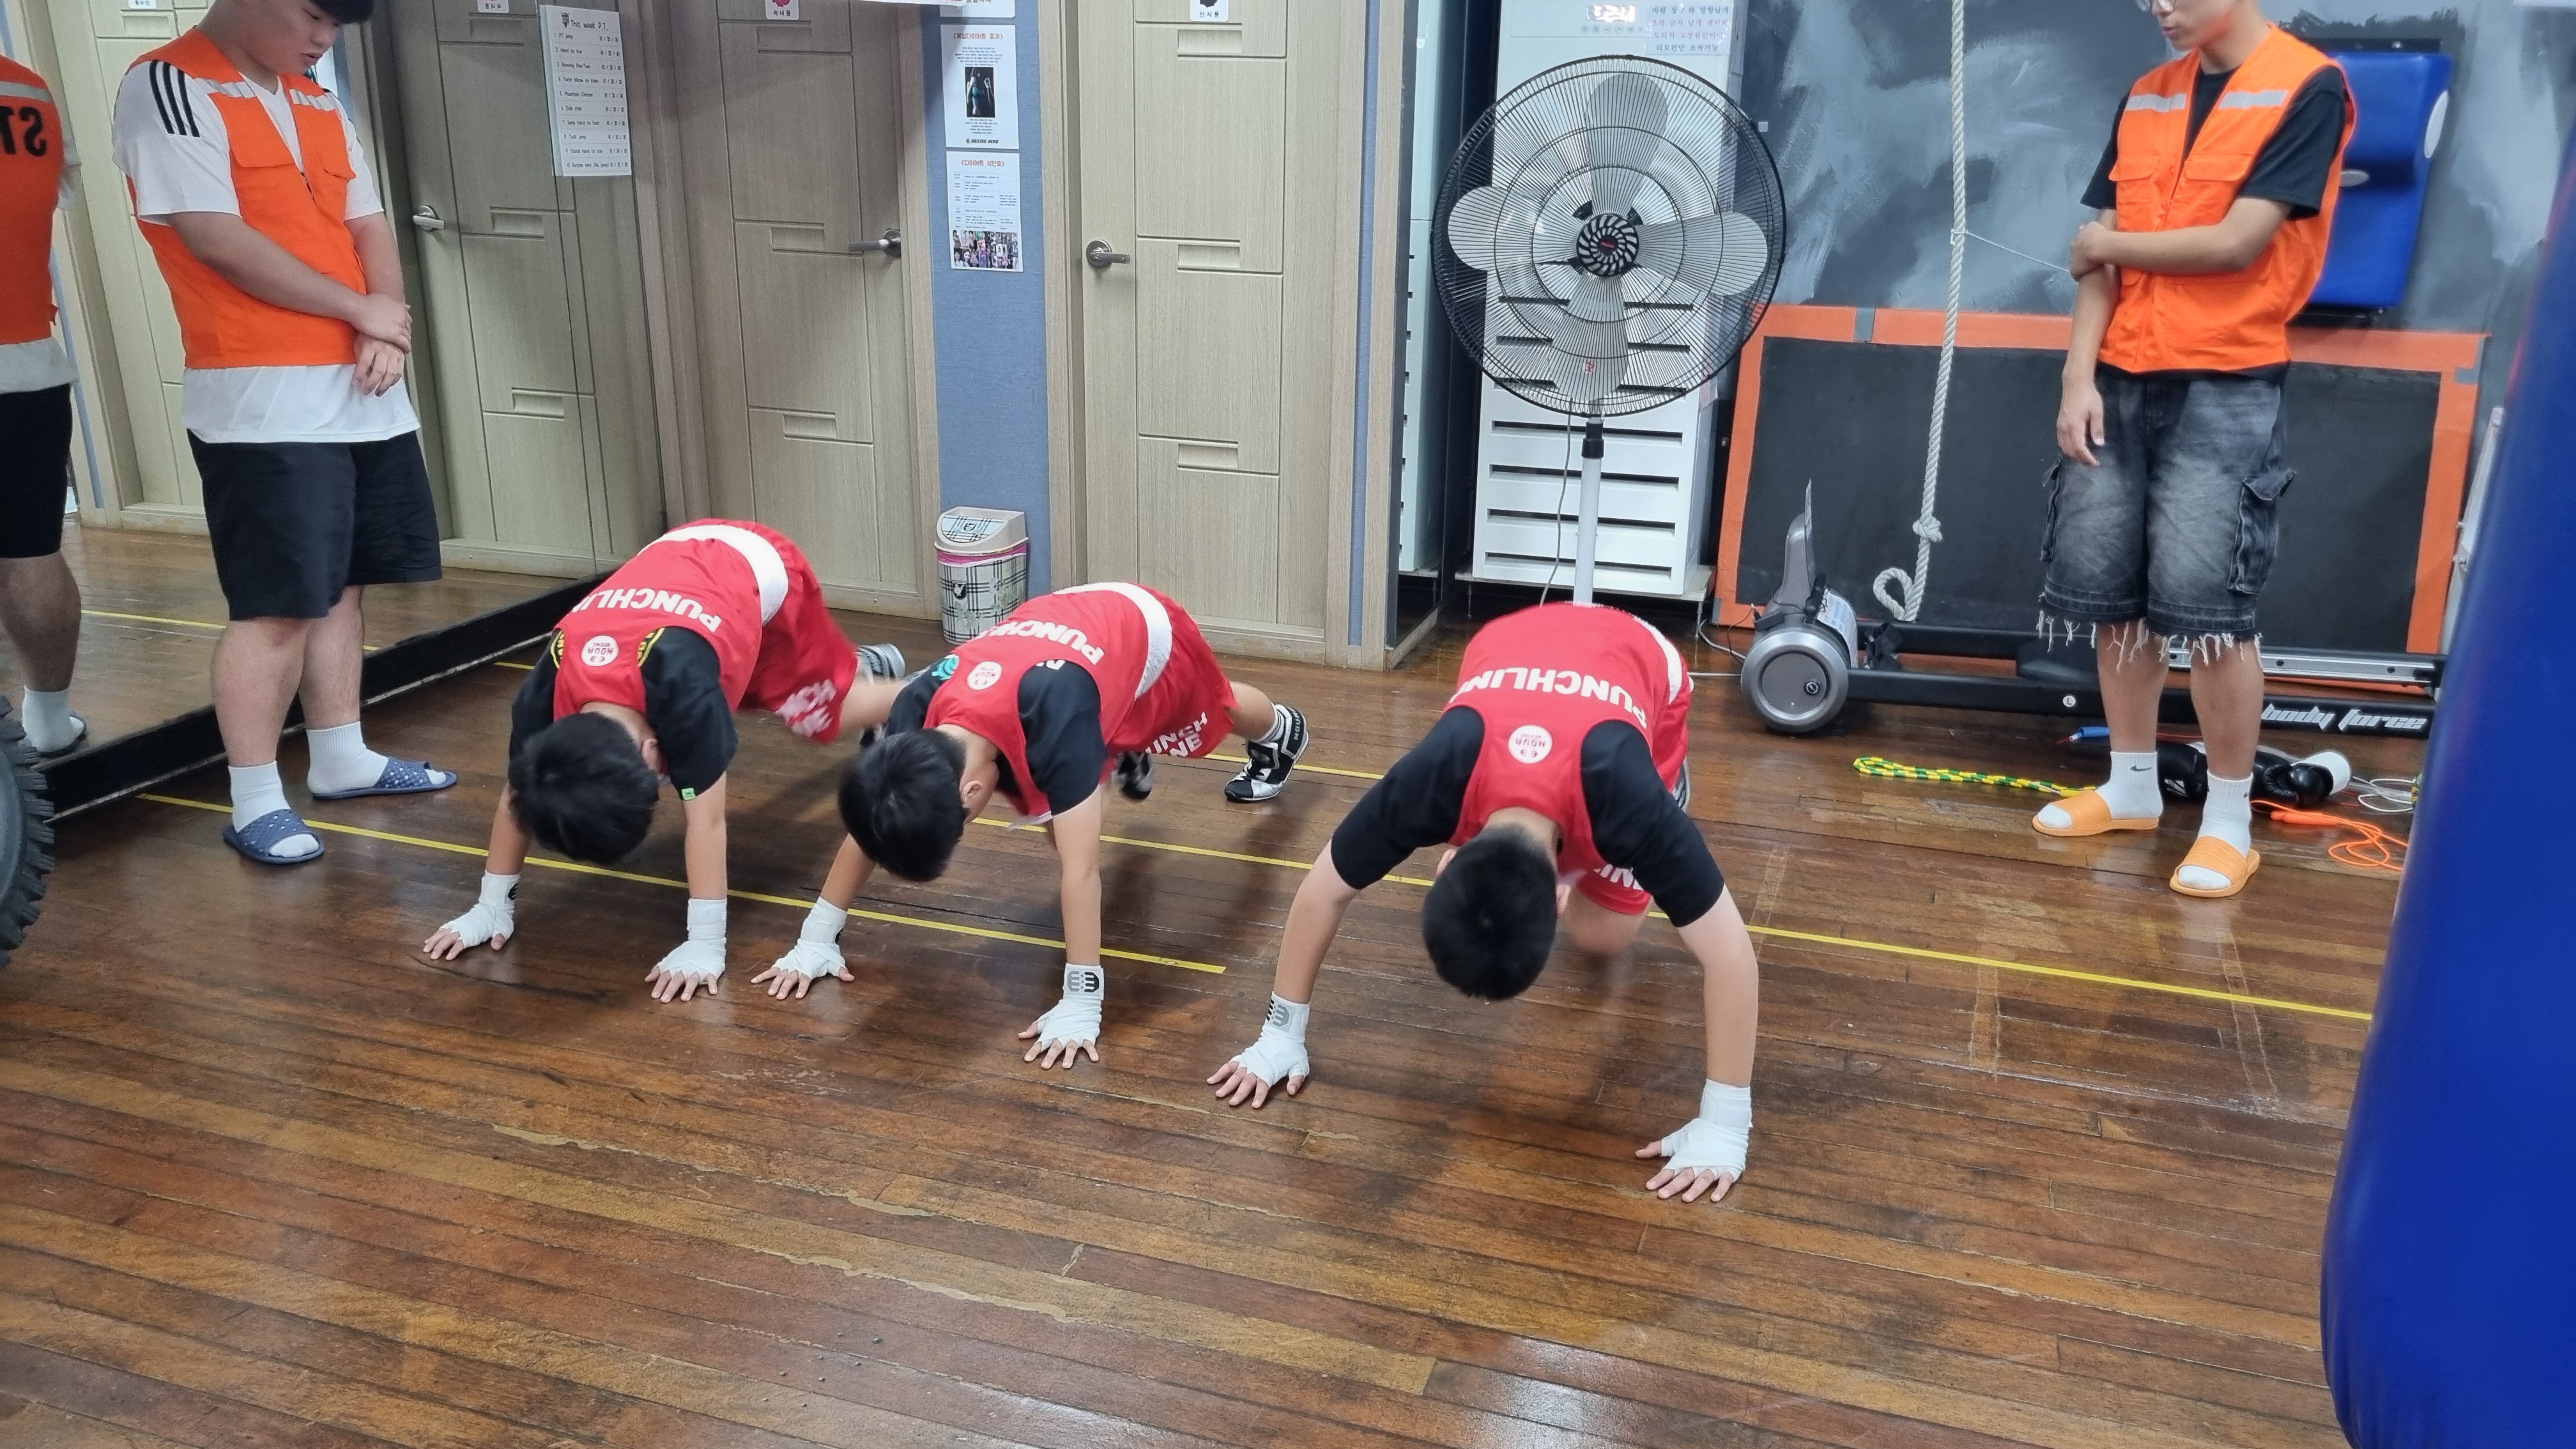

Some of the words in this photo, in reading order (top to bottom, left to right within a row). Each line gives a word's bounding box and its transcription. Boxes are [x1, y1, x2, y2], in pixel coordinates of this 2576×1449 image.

[571, 20, 581, 28] This
[2261, 703, 2335, 730] body
[2338, 708, 2427, 731] force
